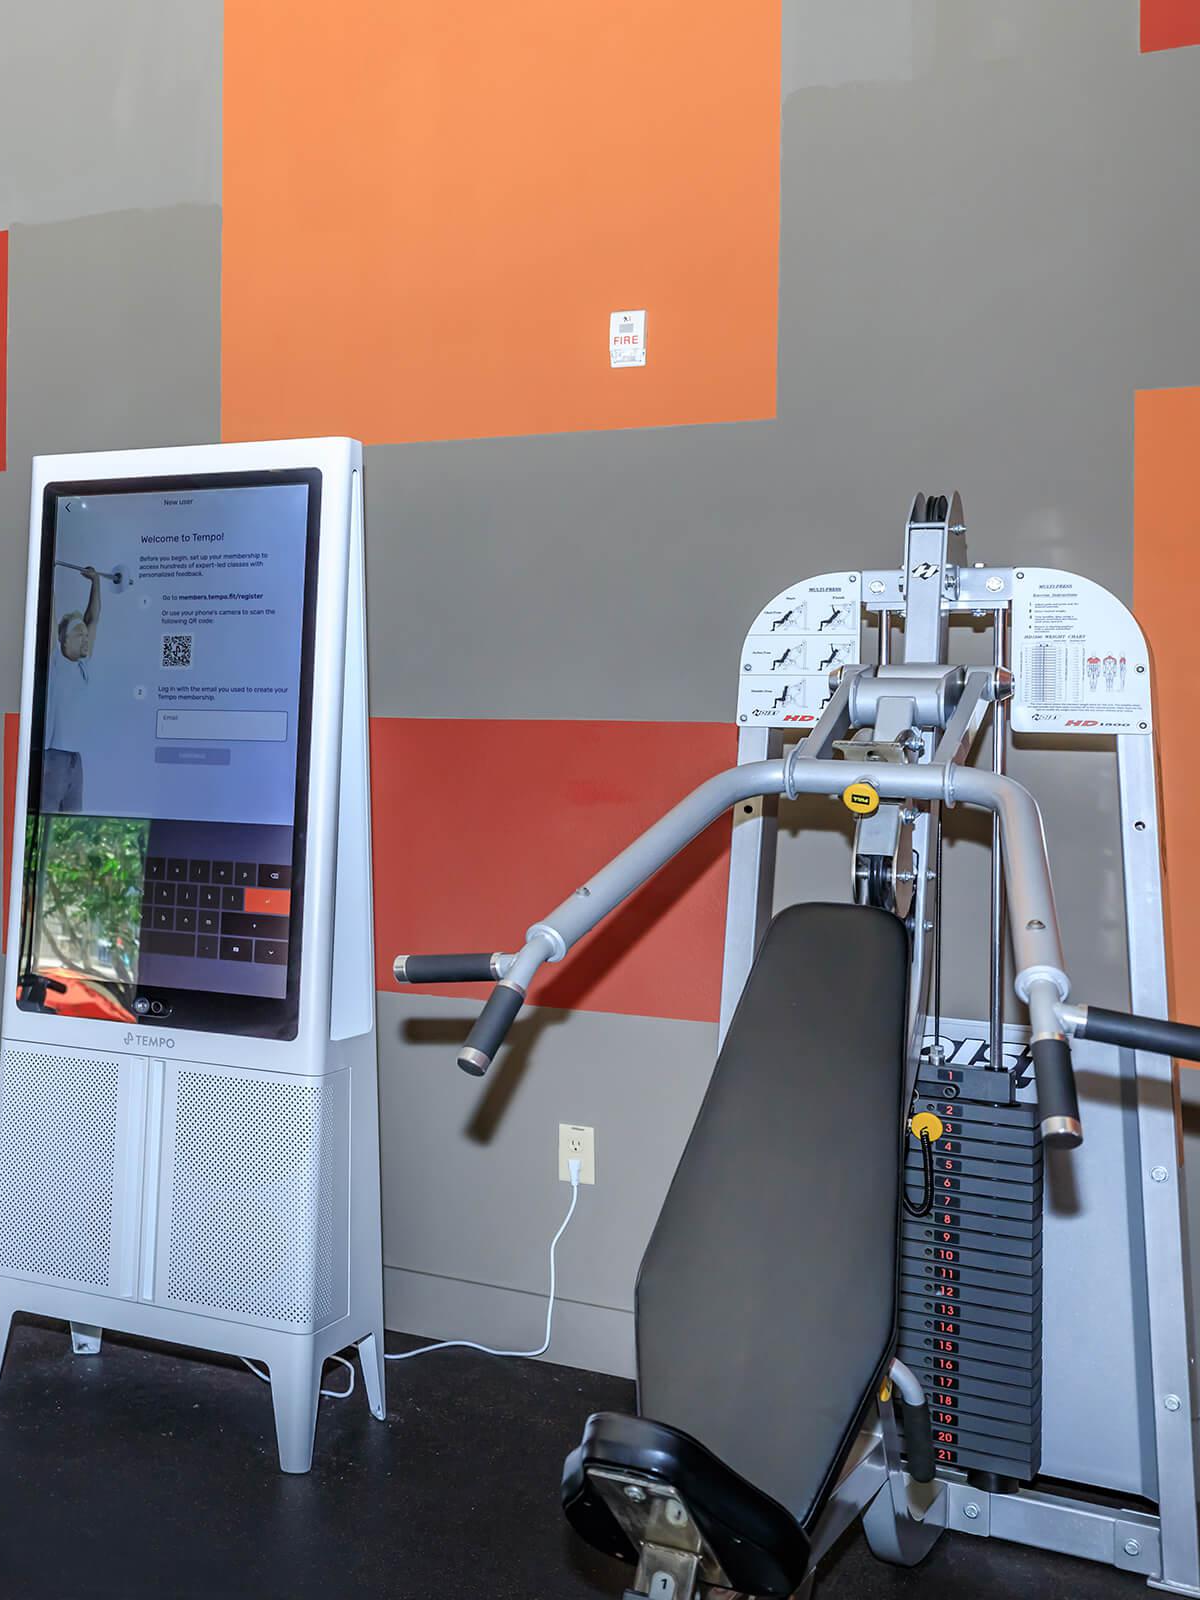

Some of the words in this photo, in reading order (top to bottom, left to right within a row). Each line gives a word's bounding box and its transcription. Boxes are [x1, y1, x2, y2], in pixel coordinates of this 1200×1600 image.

[613, 335, 639, 345] FIRE
[141, 535, 179, 544] Welcome
[181, 534, 190, 542] to
[192, 532, 225, 544] Tempo!
[209, 554, 222, 562] your
[223, 552, 261, 561] membership
[160, 562, 187, 570] hundreds
[196, 561, 227, 570] expert-led
[227, 561, 250, 569] classes
[138, 571, 176, 579] personalized
[161, 617, 188, 626] following
[188, 617, 198, 625] QR
[158, 685, 169, 693] Log
[158, 694, 177, 702] Tempo
[783, 714, 815, 722] HD
[135, 1034, 175, 1049] TEMPO
[946, 1106, 953, 1115] 2
[945, 1123, 953, 1132] 3
[944, 1142, 952, 1151] 4
[945, 1160, 953, 1169] 5
[943, 1178, 951, 1188] 6
[944, 1196, 951, 1206] 7
[943, 1214, 951, 1224] 8
[943, 1232, 950, 1242] 9
[939, 1250, 953, 1260] 10
[941, 1268, 953, 1279] 11
[940, 1286, 953, 1297] 12
[941, 1304, 954, 1315] 13
[940, 1322, 953, 1333] 14
[940, 1340, 953, 1351] 15
[939, 1359, 953, 1370] 16
[940, 1377, 953, 1388] 17
[939, 1395, 952, 1406] 18
[939, 1413, 952, 1424] 19
[938, 1432, 953, 1443] 20
[938, 1450, 951, 1461] 21
[661, 1578, 668, 1590] 1
